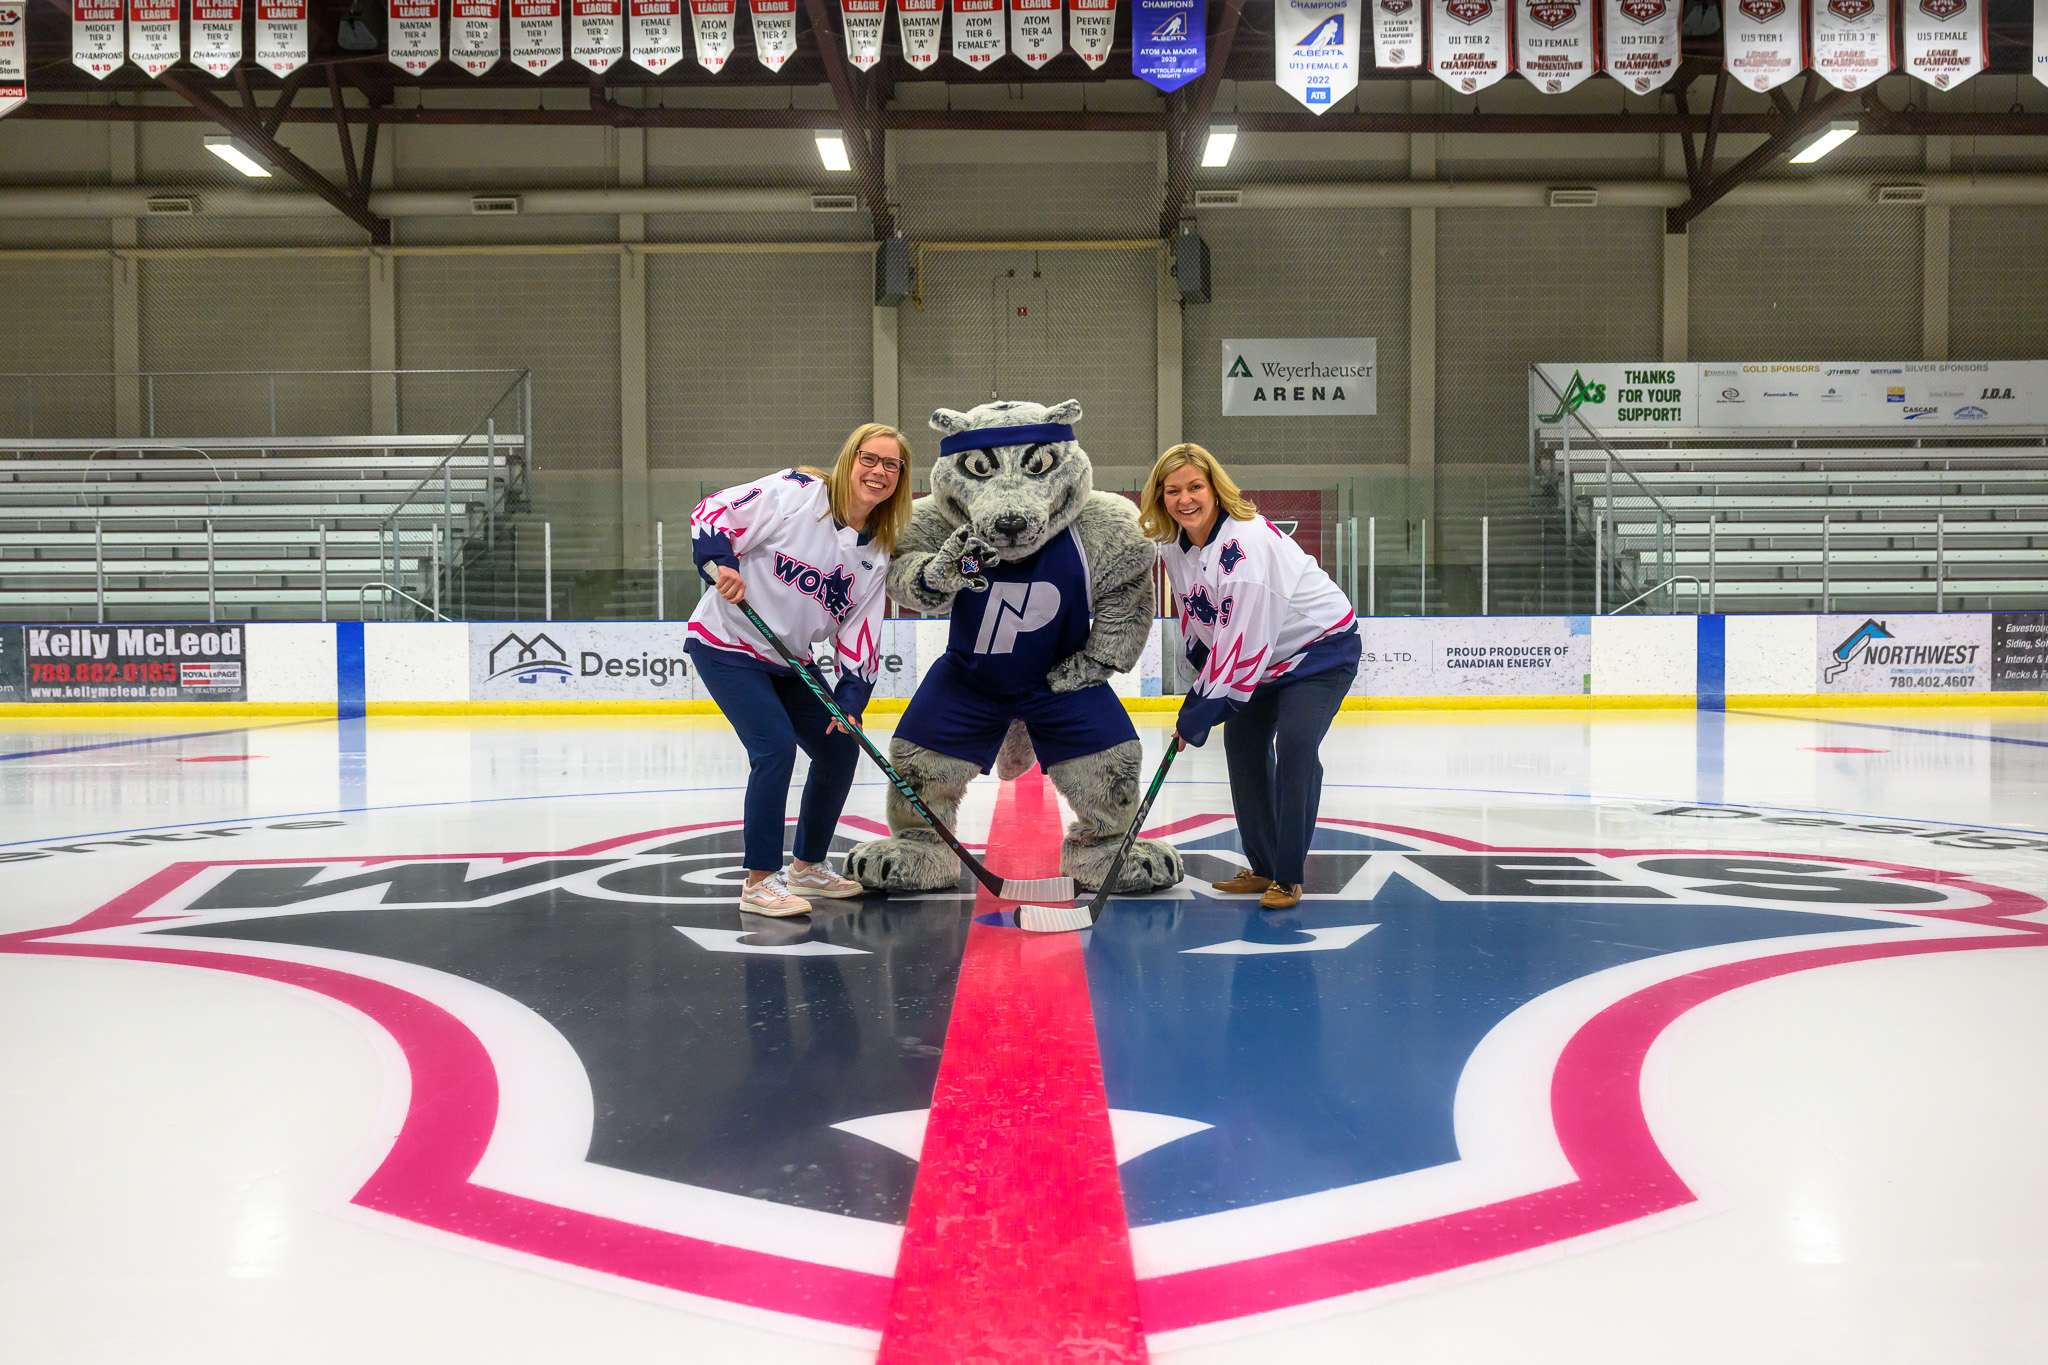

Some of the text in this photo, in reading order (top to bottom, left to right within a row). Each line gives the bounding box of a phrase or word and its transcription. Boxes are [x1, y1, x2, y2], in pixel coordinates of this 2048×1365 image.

[582, 3, 612, 14] LEAGUE
[697, 2, 728, 12] LEAGUE
[758, 1, 789, 11] LEAGUE
[848, 1, 880, 10] LEAGUE
[905, 0, 936, 9] LEAGUE
[962, 0, 993, 10] LEAGUE
[1020, 0, 1052, 8] LEAGUE
[1078, 0, 1109, 8] LEAGUE
[1142, 0, 1194, 8] CHAMPIONS
[1290, 0, 1347, 8] CHAMPIONS
[202, 9, 233, 18] LEAGUE
[267, 8, 298, 18] LEAGUE
[399, 7, 430, 17] LEAGUE
[461, 5, 492, 16] LEAGUE
[520, 5, 551, 16] LEAGUE
[640, 4, 671, 14] LEAGUE
[84, 9, 115, 19] LEAGUE
[140, 9, 171, 19] LEAGUE
[399, 21, 431, 29] BANTAM
[466, 21, 488, 29] ATOM
[521, 20, 553, 28] BANTAM
[641, 18, 671, 26] FEMALE
[701, 20, 727, 29] ATOM
[757, 20, 791, 29] PEEWEE
[902, 18, 940, 27] BANTAM
[966, 18, 992, 27] ATOM
[1024, 16, 1050, 25] ATOM
[1076, 16, 1111, 25] PEEWEE
[85, 24, 115, 32] MIDGET
[141, 24, 171, 32] MIDGET
[203, 23, 233, 31] FEMALE
[268, 23, 298, 31] PEEWEE
[851, 30, 870, 38] TIER
[908, 29, 926, 37] TIER
[966, 30, 984, 38] TIER
[1021, 28, 1038, 36] TIER
[1080, 28, 1098, 36] TIER
[1934, 32, 1968, 40] FEMALE
[1448, 35, 1490, 44] U11 TIER 2
[1528, 38, 1579, 47] U13 FEMALE
[1621, 36, 1664, 44] U13 TIER 2
[1758, 34, 1776, 42] TIER
[193, 51, 240, 59] CHAMPIONS
[391, 49, 439, 57] CHAMPIONS
[452, 49, 498, 57] CHAMPIONS
[513, 48, 561, 56] CHAMPIONS
[573, 47, 621, 55] CHAMPIONS
[632, 46, 680, 55] CHAMPIONS
[1293, 49, 1344, 57] ALBERTA
[1833, 50, 1865, 58] LEAGUE
[1926, 49, 1958, 57] LEAGUE
[75, 52, 122, 60] CHAMPIONS
[132, 52, 179, 60] CHAMPIONS
[912, 54, 931, 62] 17-18
[969, 54, 990, 62] 18-19
[1027, 53, 1047, 61] 18-19
[1084, 53, 1104, 61] 18-19
[466, 61, 486, 69] 16-17
[647, 58, 667, 66] 16-17
[1440, 60, 1497, 69] CHAMPIONS
[1526, 61, 1582, 70] REPRESENTATIVES
[1614, 59, 1672, 69] CHAMPIONS
[1734, 58, 1791, 67] CHAMPIONS
[1821, 58, 1879, 66] CHAMPIONS
[1914, 57, 1972, 66] CHAMPIONS
[1307, 76, 1330, 84] 2022
[1310, 91, 1326, 100] ATB
[1261, 361, 1373, 382] Weyerhaeuser
[1742, 365, 1821, 373] GOLD SPONSORS
[1938, 364, 1989, 372] SPONSORS
[1624, 370, 1675, 384] THANKS
[1253, 386, 1346, 401] ARENA
[1618, 389, 1681, 403] FOR YOUR
[1981, 388, 2015, 399] J.D.A.
[1618, 408, 1681, 421] SUPPORT!
[30, 629, 110, 659] Kelly
[118, 628, 240, 656] McLeod
[2005, 639, 2033, 650] Siding,
[1447, 646, 1569, 656] PROUD PRODUCER OF
[1864, 645, 1979, 665] NORTHWEST
[1447, 658, 1551, 668] CANADIAN ENERGY
[2005, 654, 2035, 664] Interior
[2036, 655, 2043, 663] &
[30, 663, 177, 682] 780.882.0185
[580, 651, 687, 687] Design
[2005, 670, 2030, 679] Decks
[2032, 670, 2039, 679] &
[1890, 676, 1975, 688] 780.402.4607
[31, 685, 177, 699] www.kellymcleod.com
